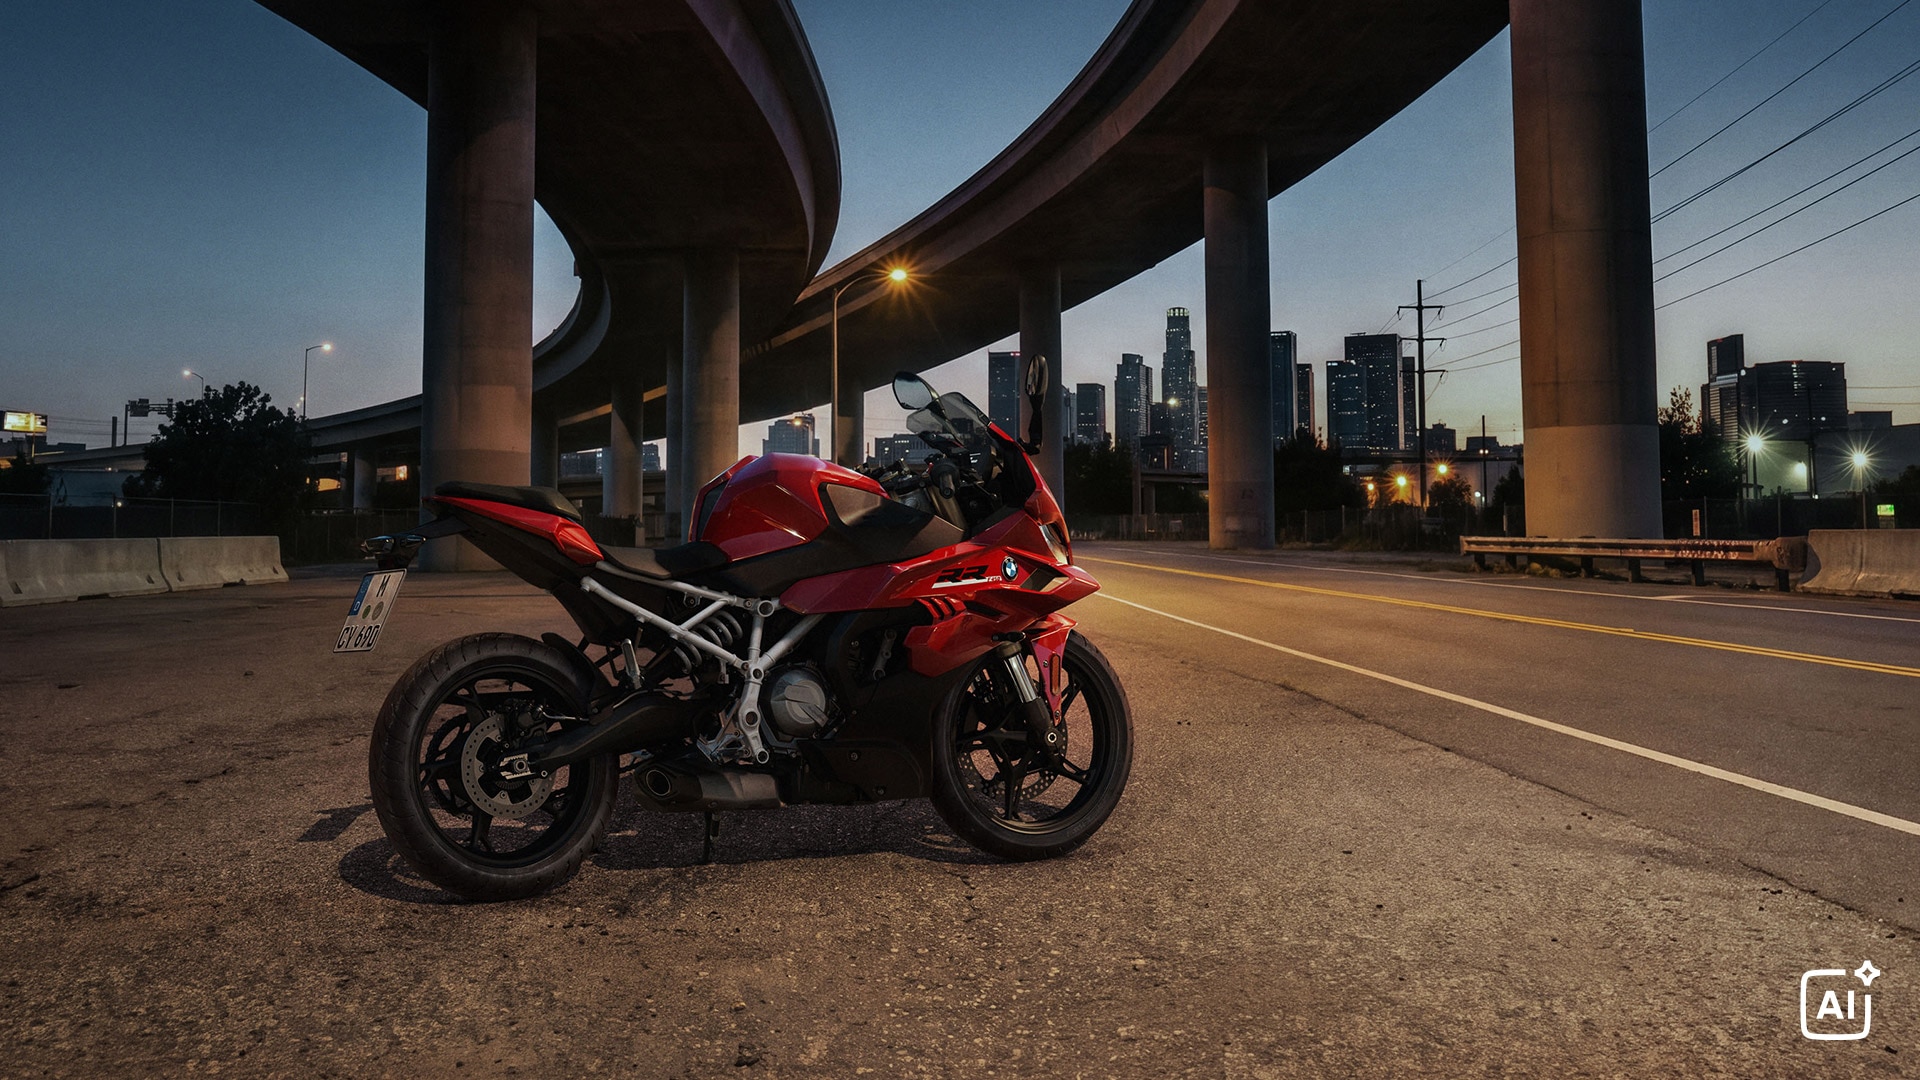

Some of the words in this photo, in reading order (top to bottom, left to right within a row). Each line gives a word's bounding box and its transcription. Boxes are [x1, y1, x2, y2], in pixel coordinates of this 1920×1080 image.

[376, 574, 391, 597] M
[936, 565, 989, 583] RR
[337, 626, 358, 649] CY
[354, 625, 380, 648] 690
